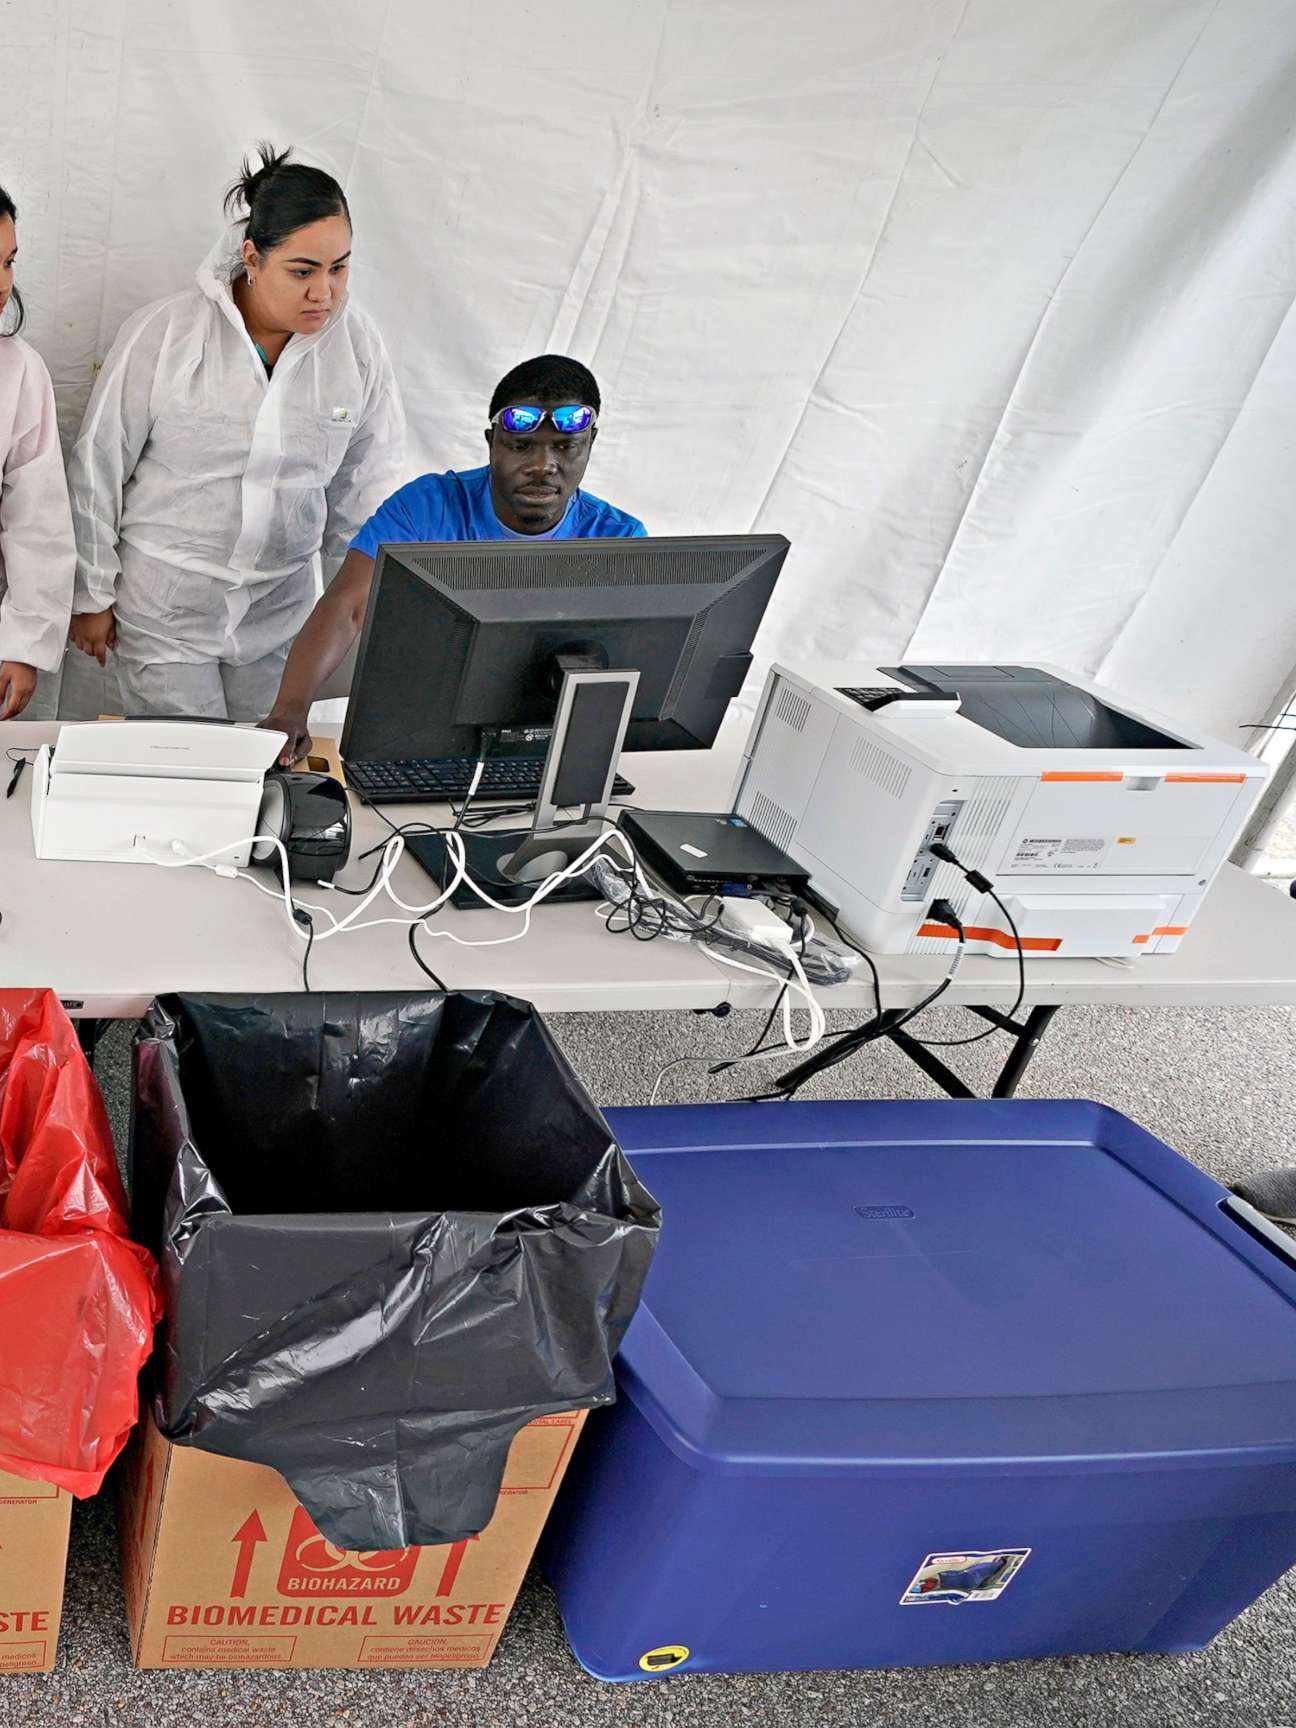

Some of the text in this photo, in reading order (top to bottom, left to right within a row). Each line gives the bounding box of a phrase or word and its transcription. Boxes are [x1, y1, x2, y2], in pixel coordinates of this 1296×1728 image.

[287, 1577, 401, 1590] BIOHAZARD
[166, 1604, 506, 1625] BIOMEDICAL WASTE
